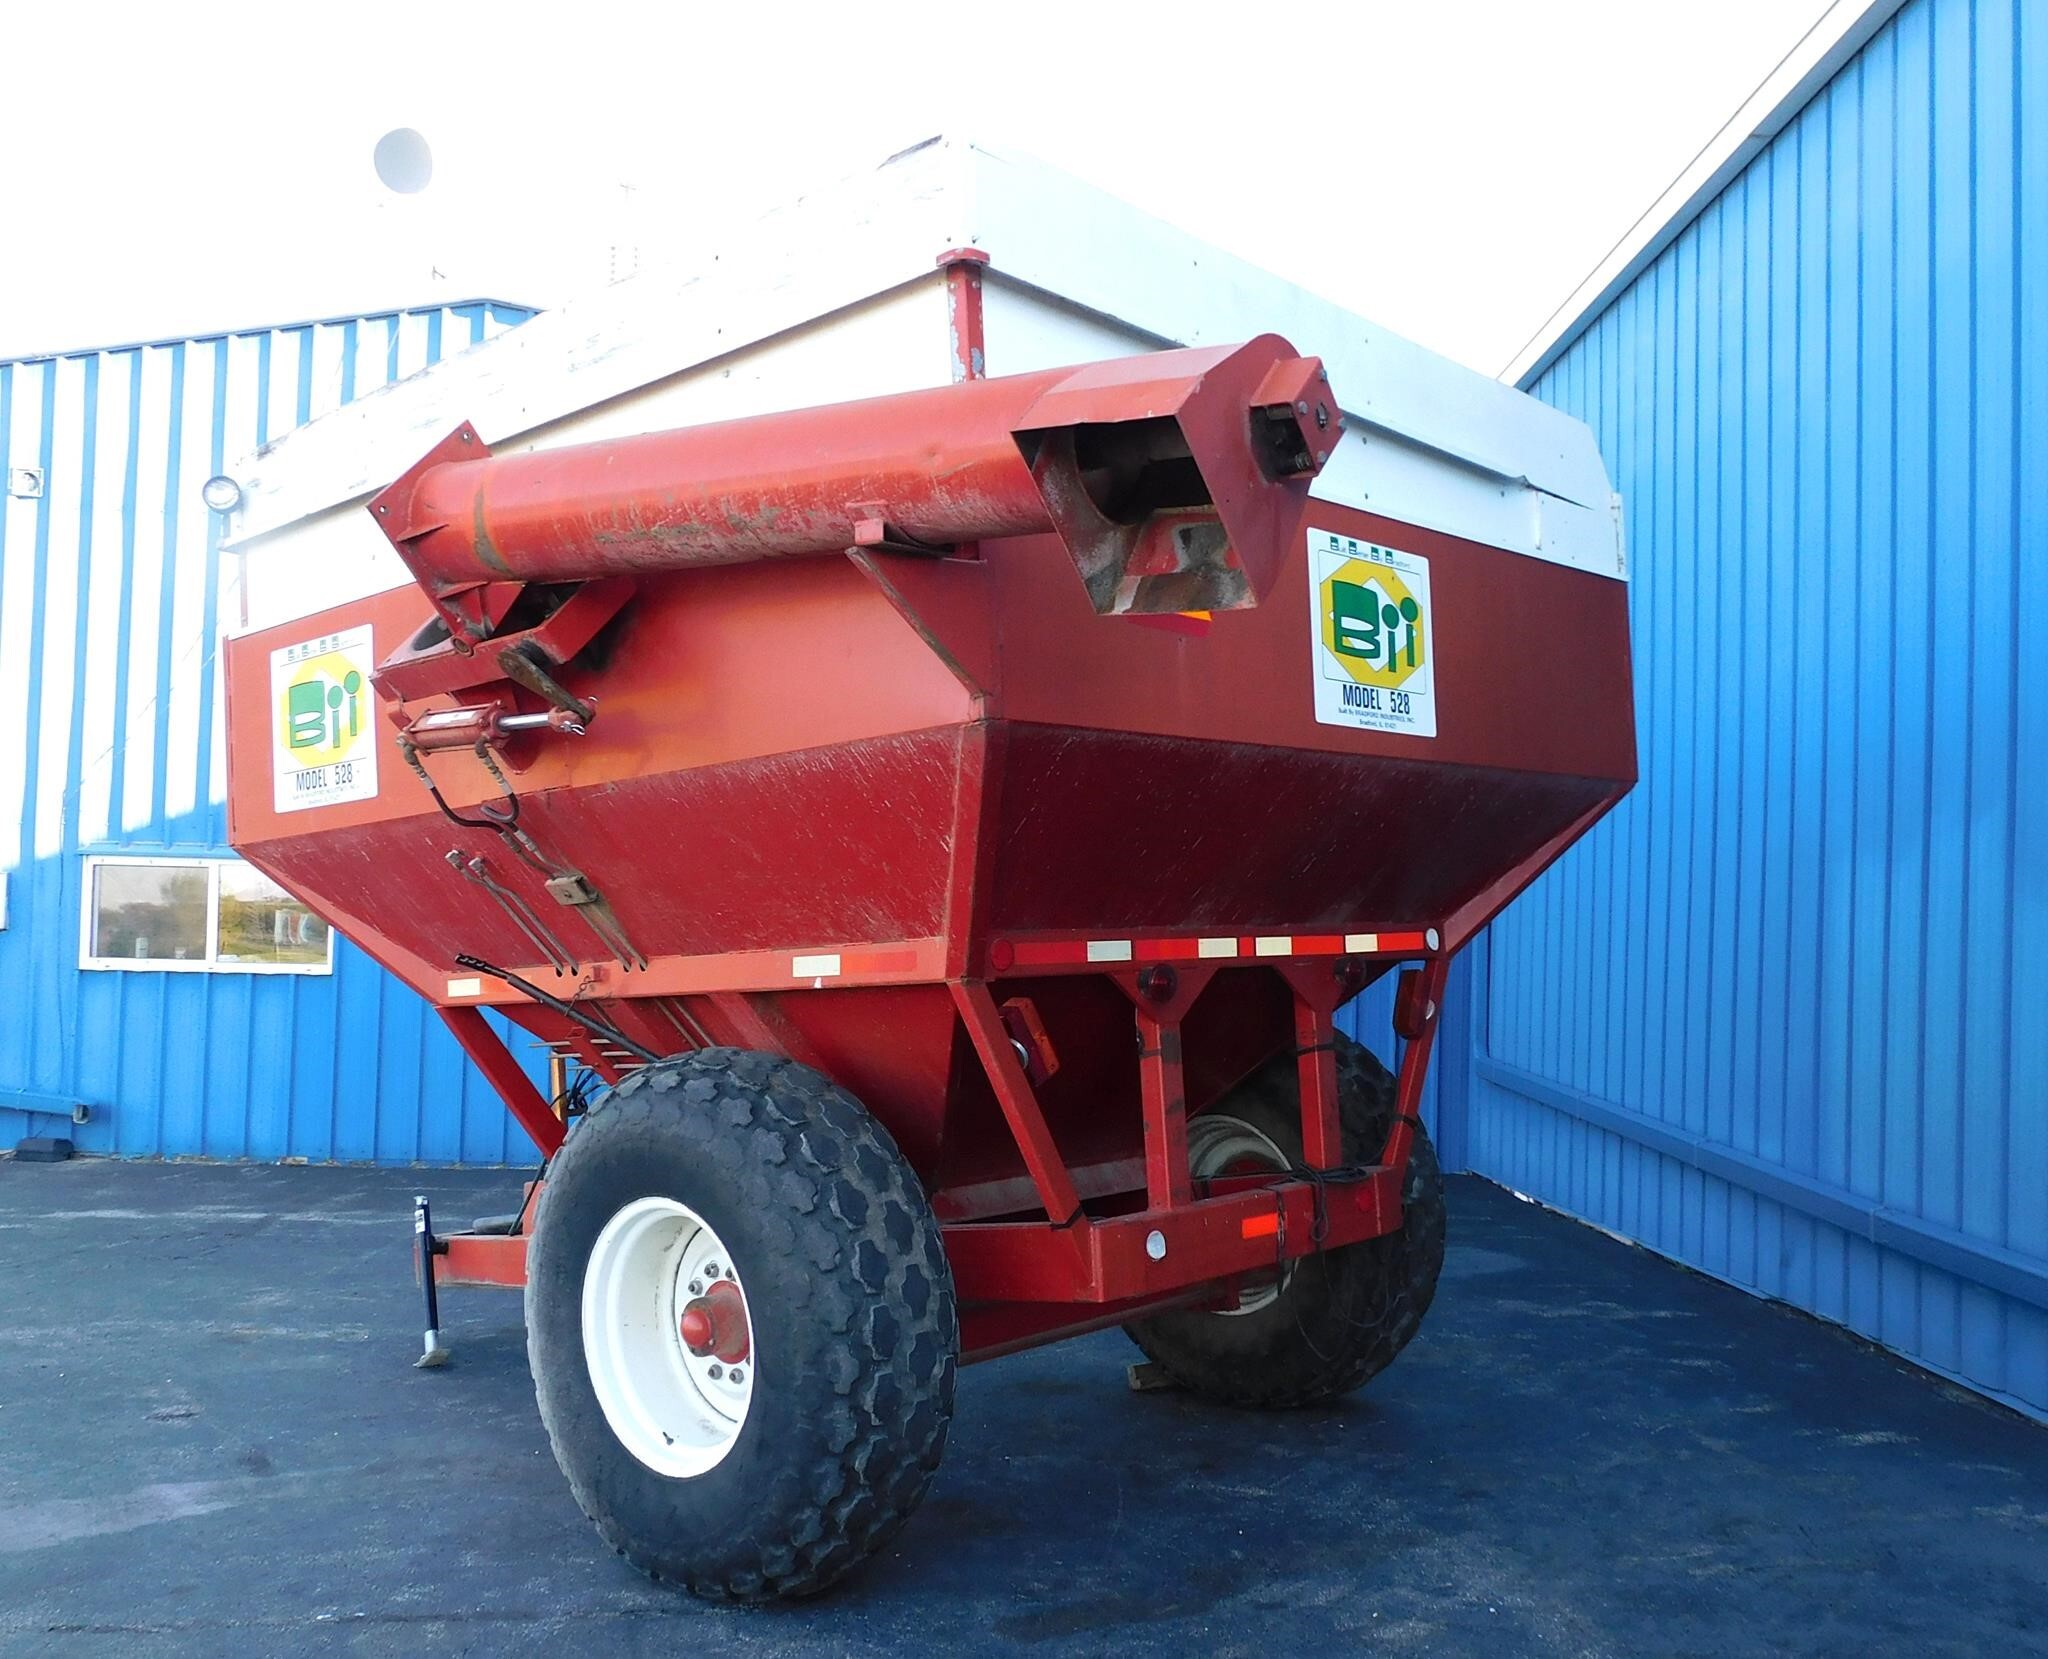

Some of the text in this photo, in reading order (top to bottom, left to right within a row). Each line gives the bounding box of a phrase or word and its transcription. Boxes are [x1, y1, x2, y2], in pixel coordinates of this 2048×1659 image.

[1331, 579, 1418, 673] Bii
[289, 670, 360, 749] Bii
[1342, 683, 1410, 715] MODEL 528
[296, 770, 328, 792] MODEL
[334, 763, 353, 785] 528
